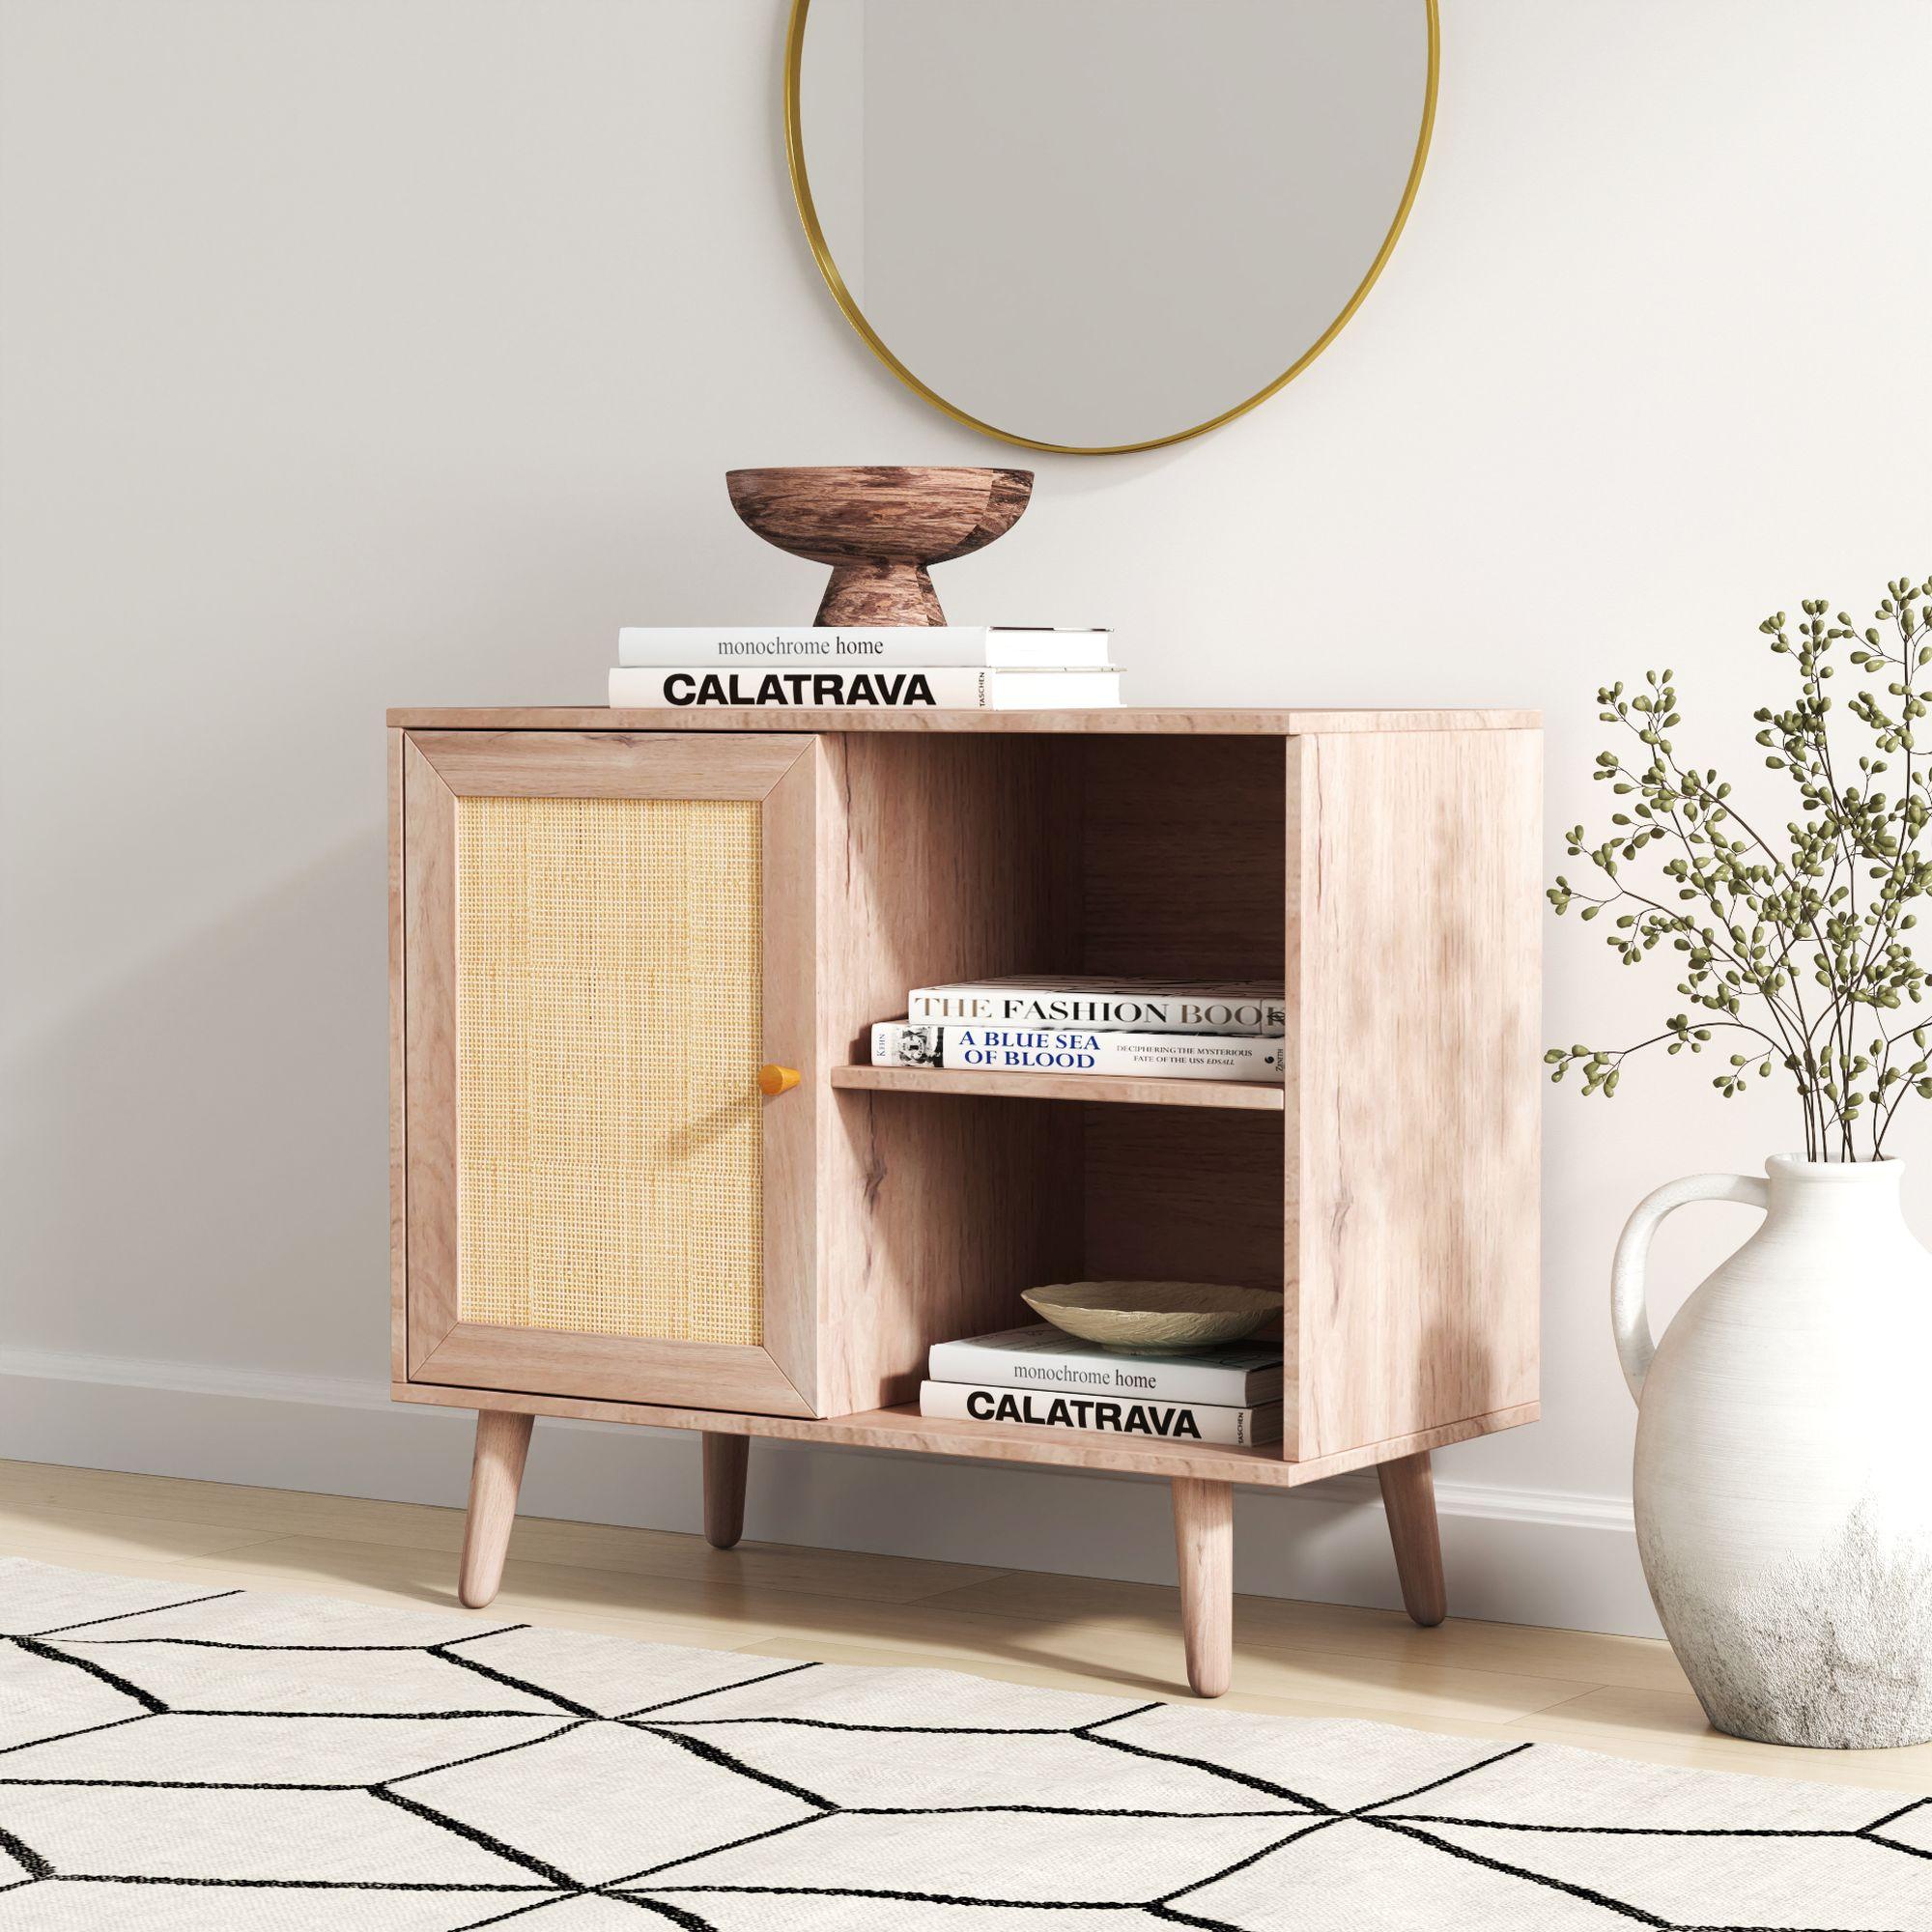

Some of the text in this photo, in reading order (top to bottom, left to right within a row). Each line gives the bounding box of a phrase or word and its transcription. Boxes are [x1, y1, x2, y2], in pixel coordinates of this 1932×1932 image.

[718, 636, 884, 655] monochrome home
[663, 673, 936, 706] CALATRAVA
[915, 997, 992, 1019] THE
[1004, 999, 1170, 1024] FASHION
[959, 1031, 1100, 1051] A BLUE SEA
[1116, 1045, 1253, 1057] DECIPHERING THE MYSTERIOUS
[964, 1050, 1095, 1068] OF BLOOD
[1014, 1364, 1157, 1389] monochrome home
[966, 1391, 1203, 1439] CALATRAVA
